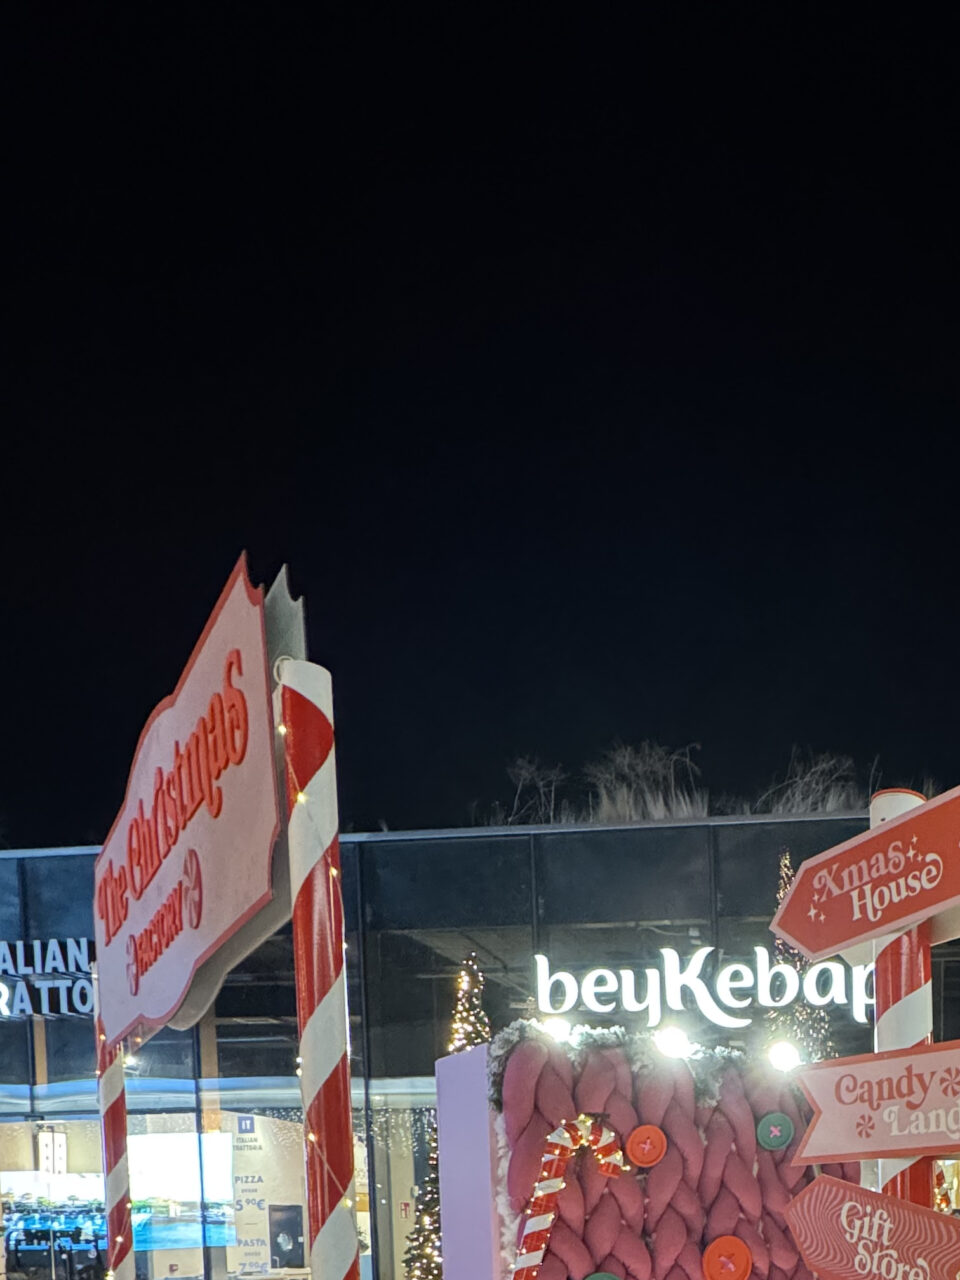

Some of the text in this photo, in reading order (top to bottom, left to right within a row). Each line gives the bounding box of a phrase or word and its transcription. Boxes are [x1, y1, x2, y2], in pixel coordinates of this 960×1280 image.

[98, 648, 248, 947] The Christmas
[812, 840, 906, 903] Xmas
[850, 852, 944, 922] House
[135, 880, 185, 977] FACTORY
[834, 1063, 938, 1112] Candy
[234, 1175, 265, 1185] PIZZA
[238, 1238, 268, 1248] PASTA
[840, 1201, 894, 1247] Gift
